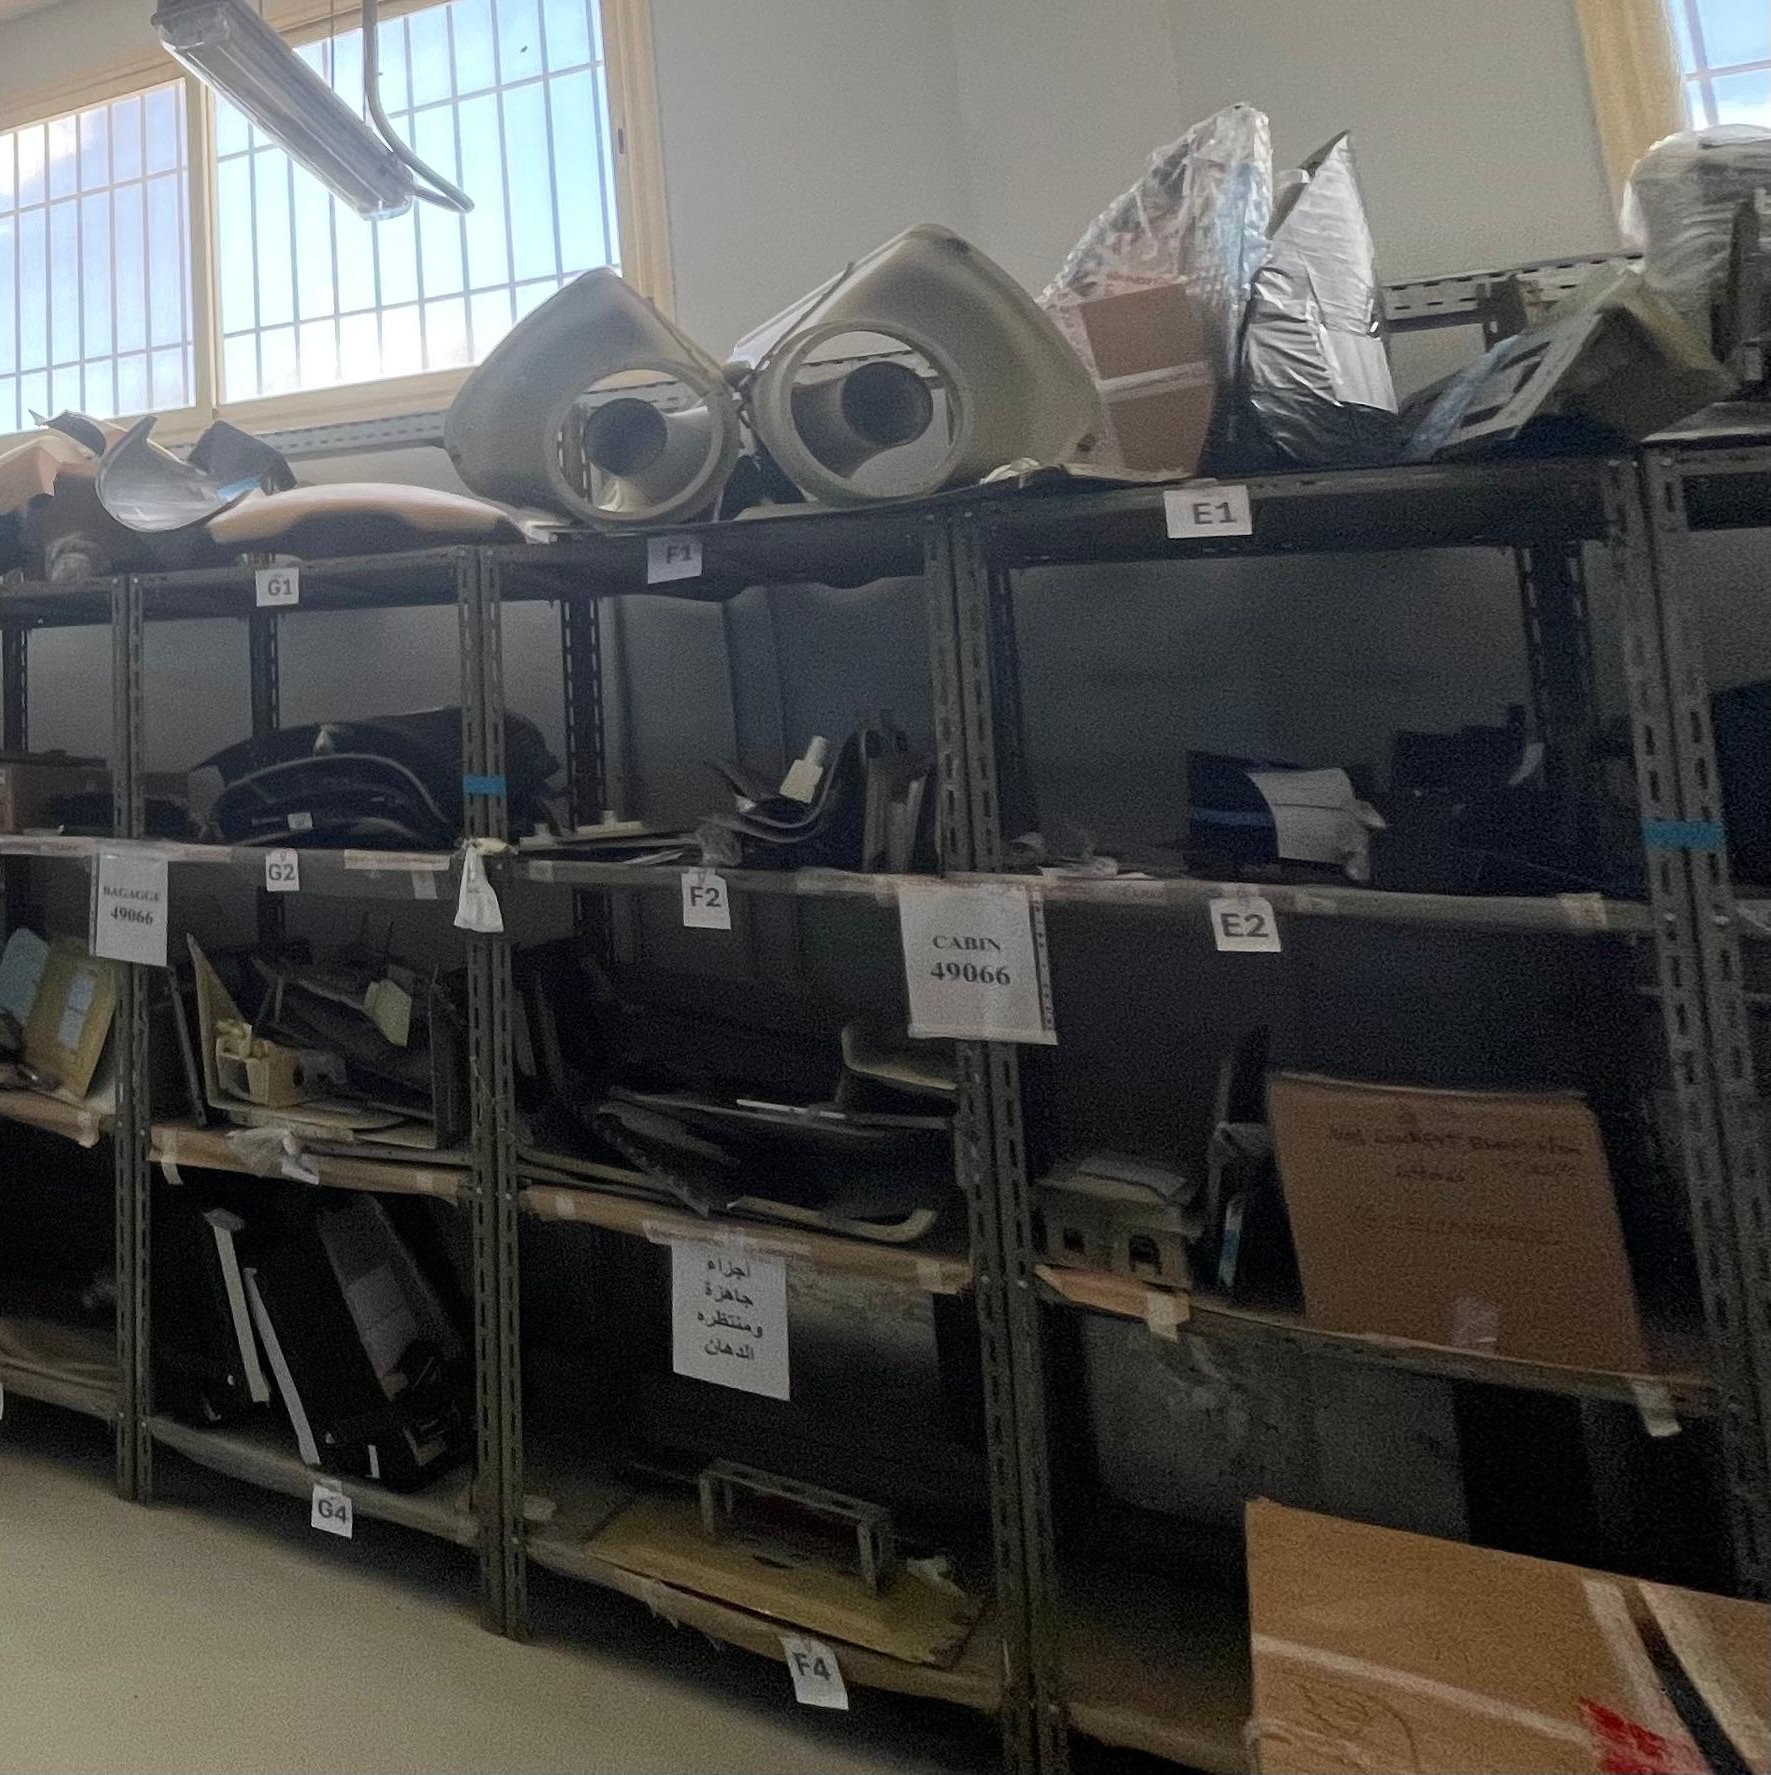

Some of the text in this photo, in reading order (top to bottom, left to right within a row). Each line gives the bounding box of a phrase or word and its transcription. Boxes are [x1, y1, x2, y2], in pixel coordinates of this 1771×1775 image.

[1191, 501, 1238, 526] E1
[665, 543, 695, 565] F1
[266, 577, 294, 598] G1
[267, 862, 297, 884] G2
[689, 884, 722, 909] F2
[1220, 912, 1269, 938] E2
[931, 935, 1002, 953] CABIN
[929, 961, 1012, 986] 49066
[703, 1338, 757, 1362] الدهان
[317, 1498, 349, 1525] G4
[792, 1651, 831, 1682] F4
